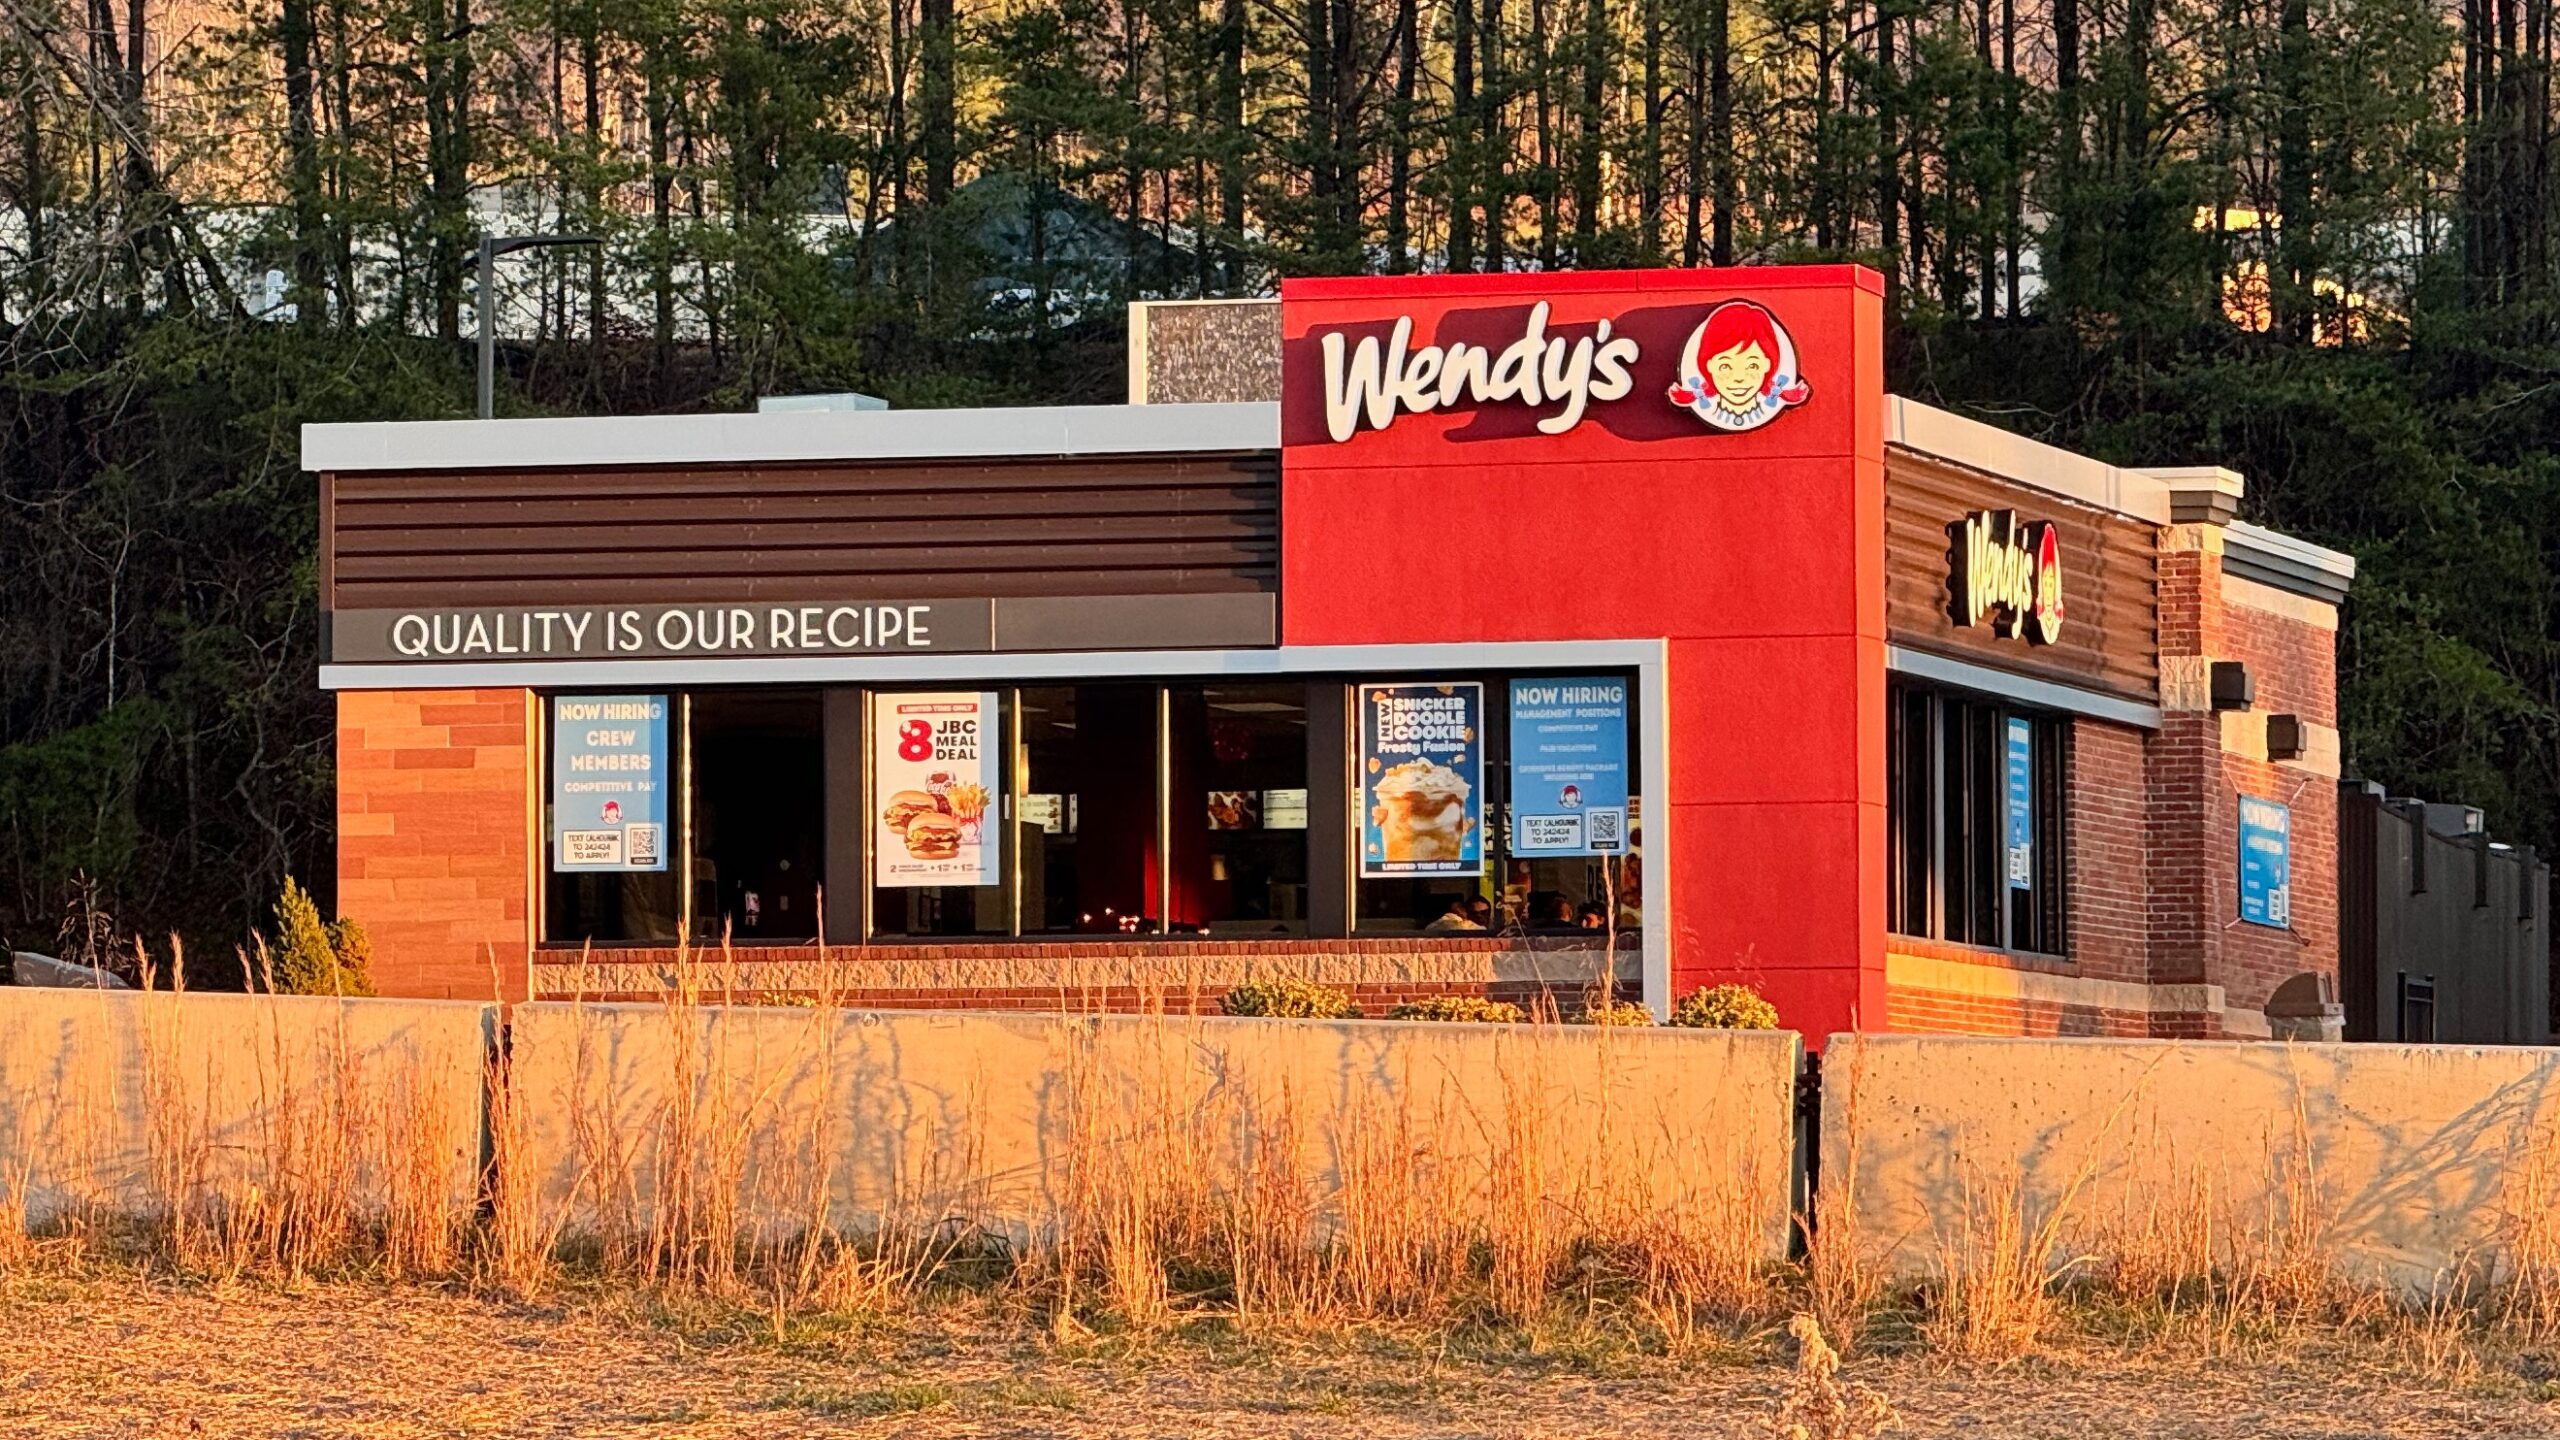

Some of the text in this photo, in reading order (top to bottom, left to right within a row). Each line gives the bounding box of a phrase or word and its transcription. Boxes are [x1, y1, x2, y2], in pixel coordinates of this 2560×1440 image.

[1321, 300, 1640, 443] Wendy's
[1967, 510, 2033, 640] Wendy's
[392, 605, 931, 657] QUALITY IS OUR RECIPE
[1516, 686, 1623, 705] NOW HIRING
[560, 703, 662, 720] NOW HIRING
[1393, 697, 1466, 711] SNICKER
[1380, 702, 1391, 738] NEW
[1393, 710, 1466, 725] DOODLE
[936, 720, 976, 734] JBC
[1394, 725, 1466, 740] COOKIE
[586, 730, 636, 746] CREW
[898, 719, 933, 762] 8
[936, 736, 977, 746] MEAL
[936, 748, 977, 760] DEAL
[1377, 740, 1465, 756] Frosty Fusion
[571, 754, 651, 771] MEMBERS
[564, 781, 657, 792] COMPETITIVE PAY
